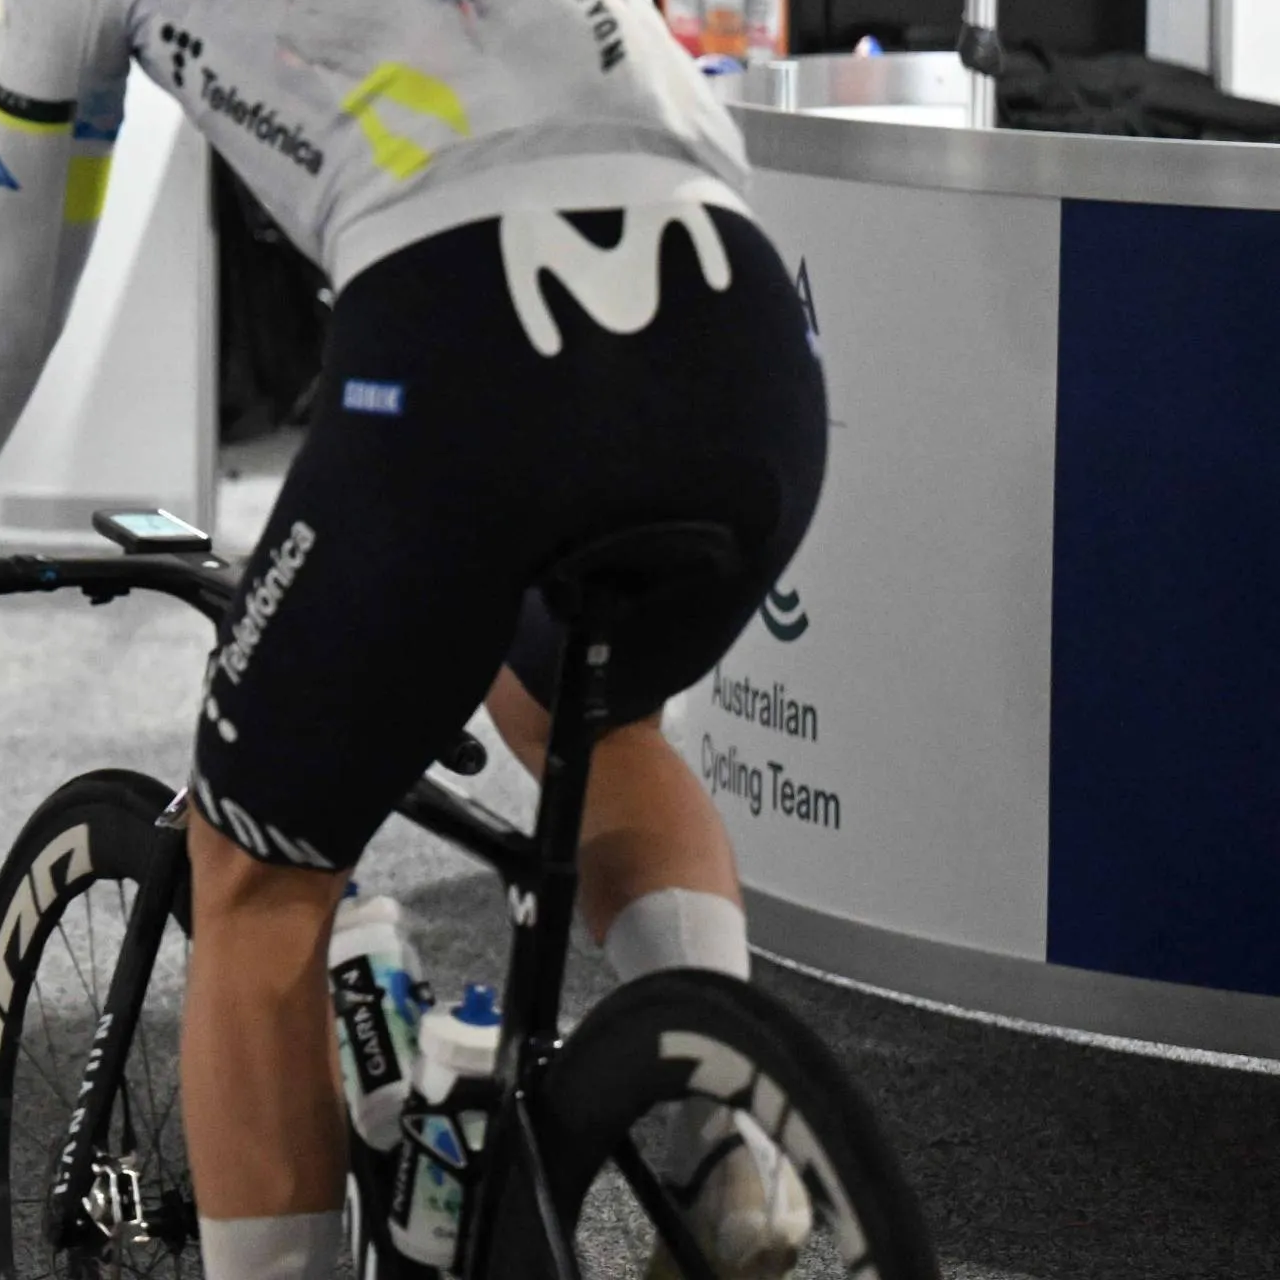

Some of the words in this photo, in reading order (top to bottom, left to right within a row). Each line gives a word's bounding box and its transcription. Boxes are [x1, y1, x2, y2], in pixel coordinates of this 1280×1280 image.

[201, 66, 324, 178] Telefónica
[712, 664, 818, 742] Australian
[702, 732, 762, 817] Cycling
[767, 760, 841, 830] Team
